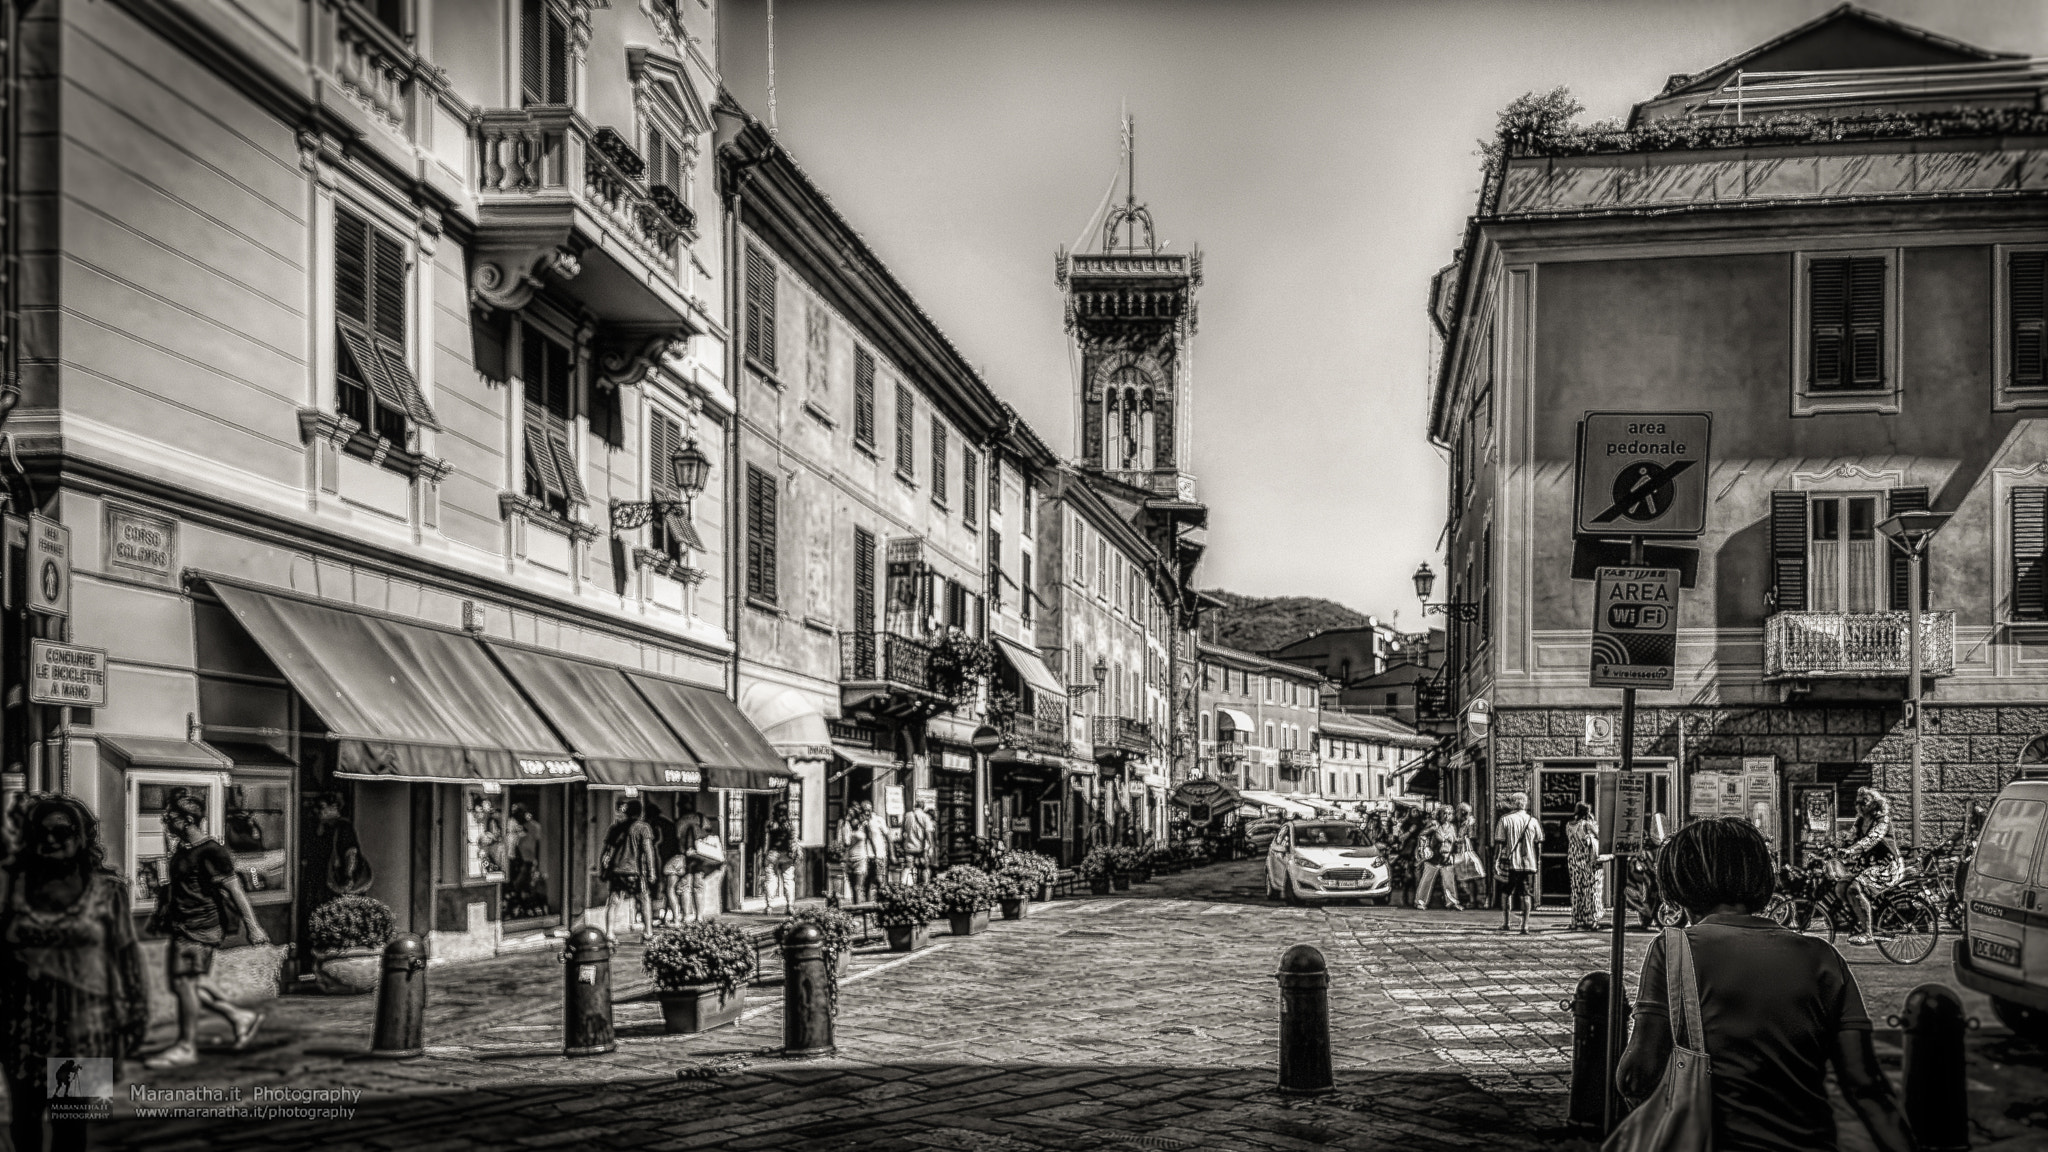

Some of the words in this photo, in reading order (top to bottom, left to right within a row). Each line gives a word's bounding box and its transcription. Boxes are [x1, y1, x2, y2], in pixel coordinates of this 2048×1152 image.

[1628, 423, 1666, 434] area
[1606, 440, 1687, 457] pedonale
[124, 524, 161, 547] CORSO
[1609, 583, 1670, 602] AREA
[45, 648, 97, 669] CONDURRE
[35, 663, 49, 679] LE
[51, 665, 104, 686] BICICLETTE
[51, 682, 60, 696] A
[61, 683, 91, 700] MANO
[519, 759, 546, 775] TOP
